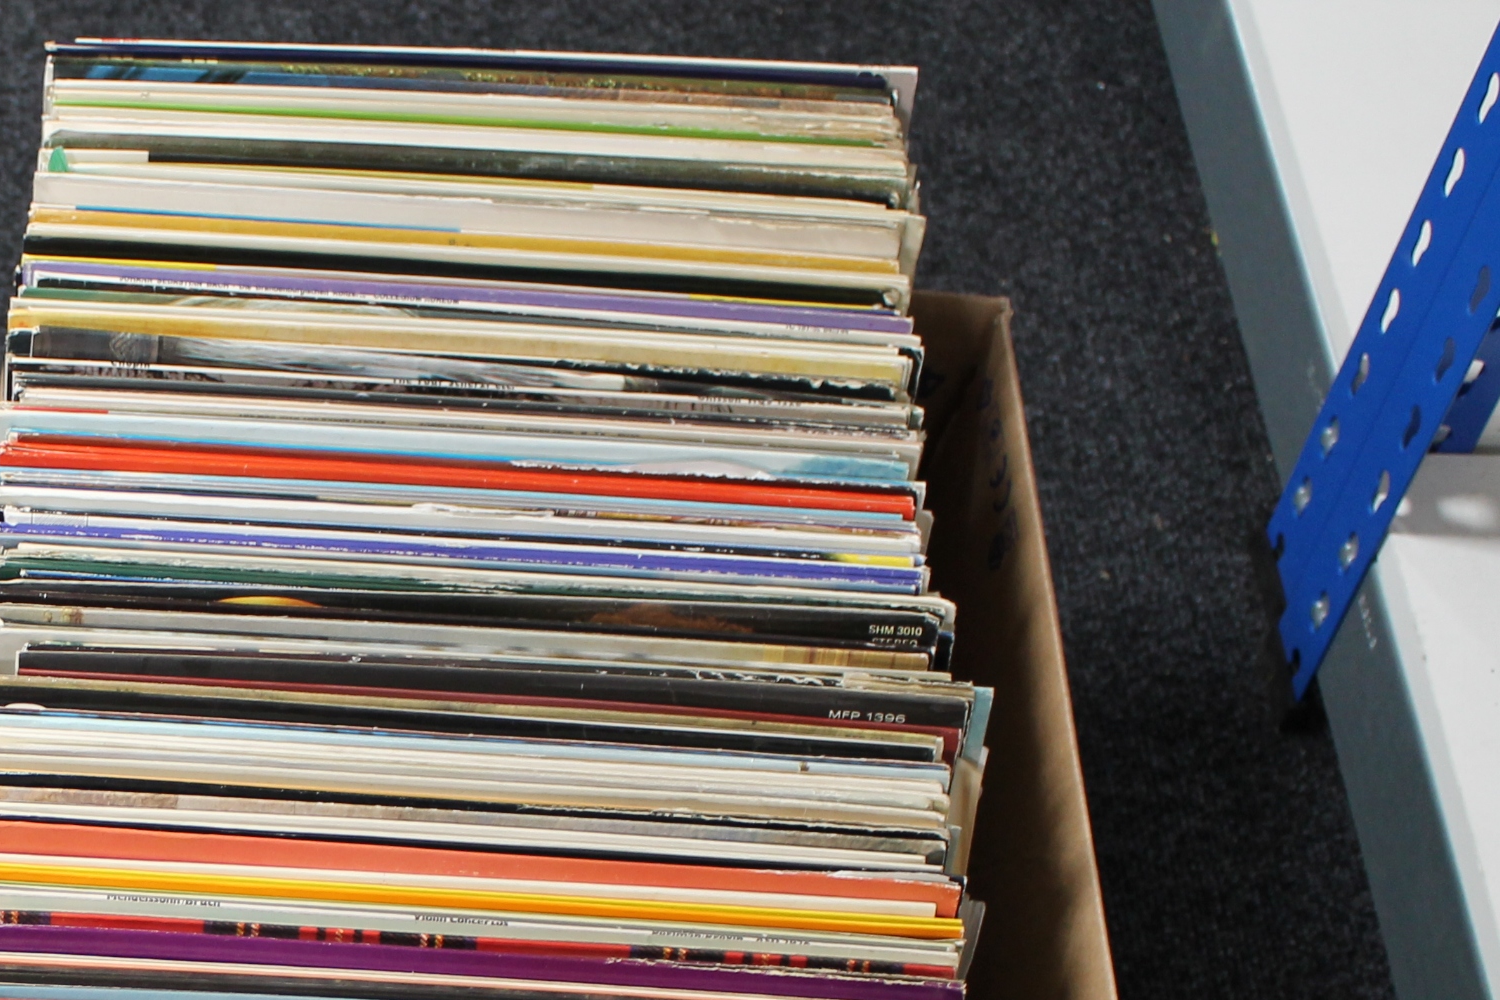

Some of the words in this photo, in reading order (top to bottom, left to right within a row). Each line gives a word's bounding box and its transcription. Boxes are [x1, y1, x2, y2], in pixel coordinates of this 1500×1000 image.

[868, 624, 894, 635] SHM
[896, 626, 923, 637] 3010
[828, 709, 861, 721] MFP
[866, 711, 906, 725] 1396
